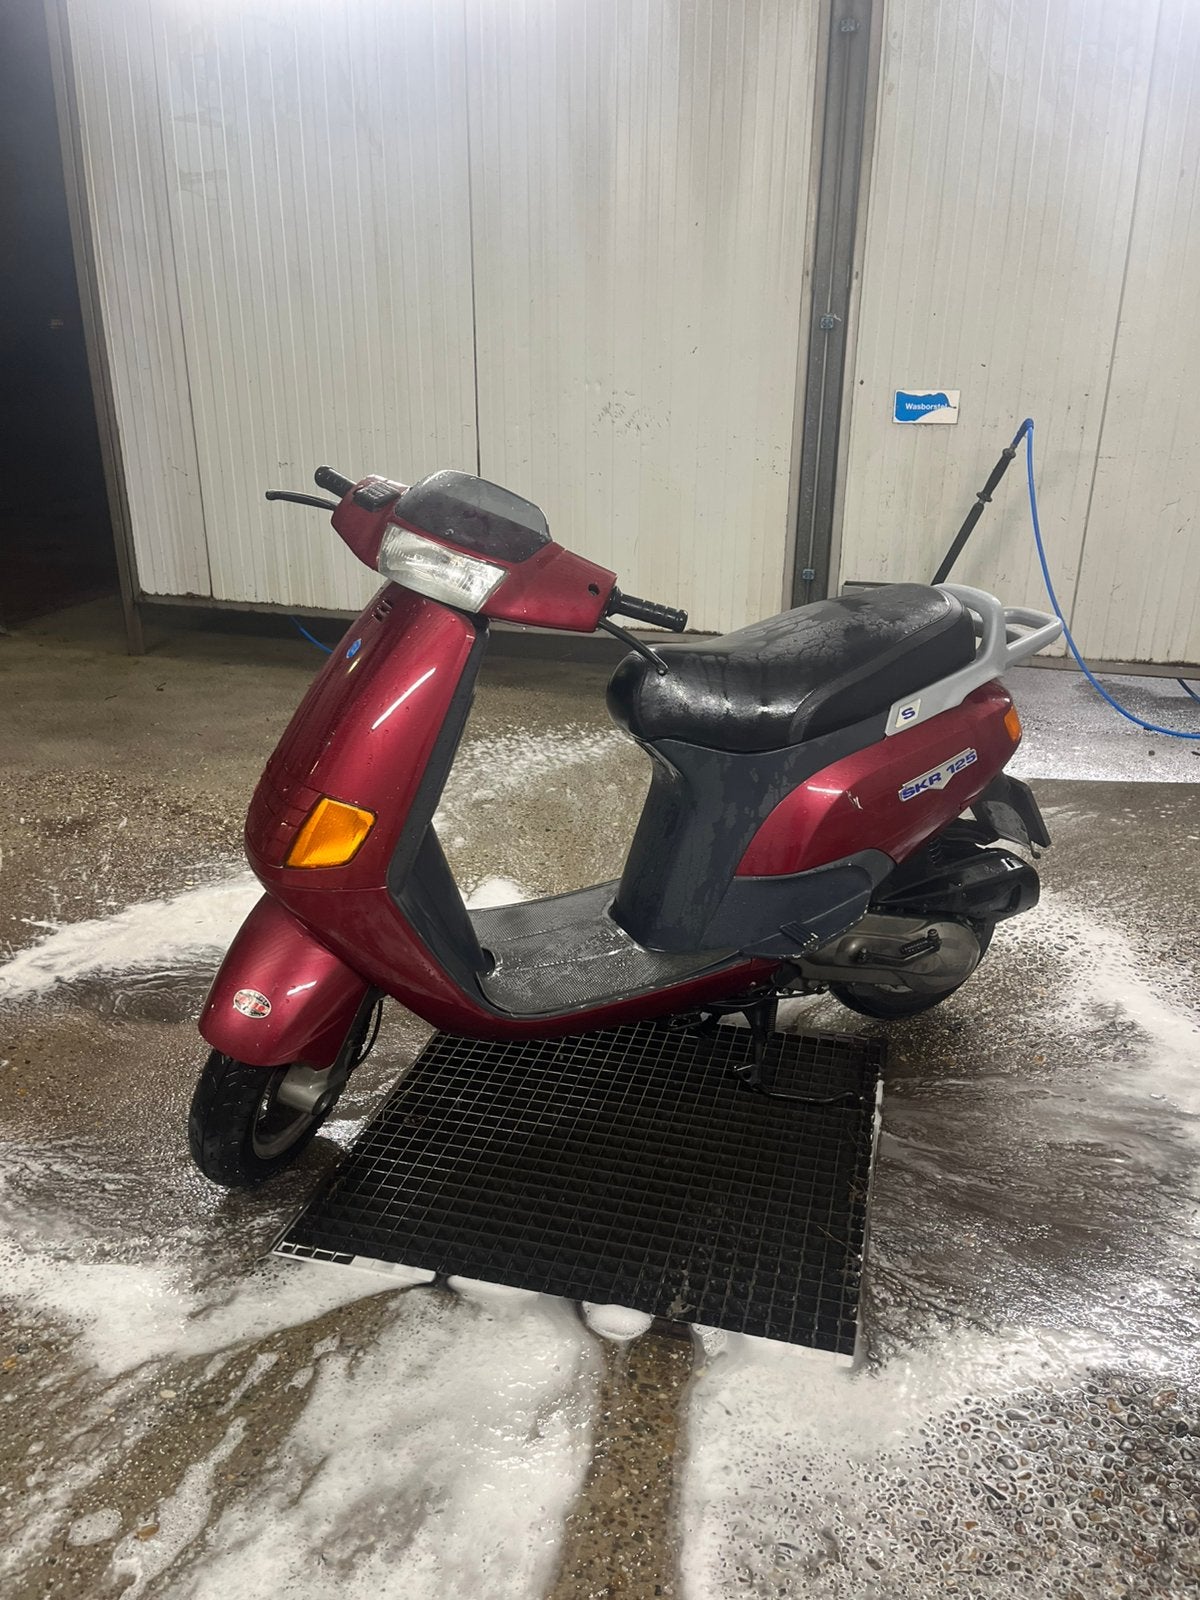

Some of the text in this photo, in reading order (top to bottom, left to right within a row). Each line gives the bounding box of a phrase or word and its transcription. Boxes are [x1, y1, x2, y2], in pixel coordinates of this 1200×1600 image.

[901, 707, 916, 720] S
[902, 752, 977, 799] SKR 125
